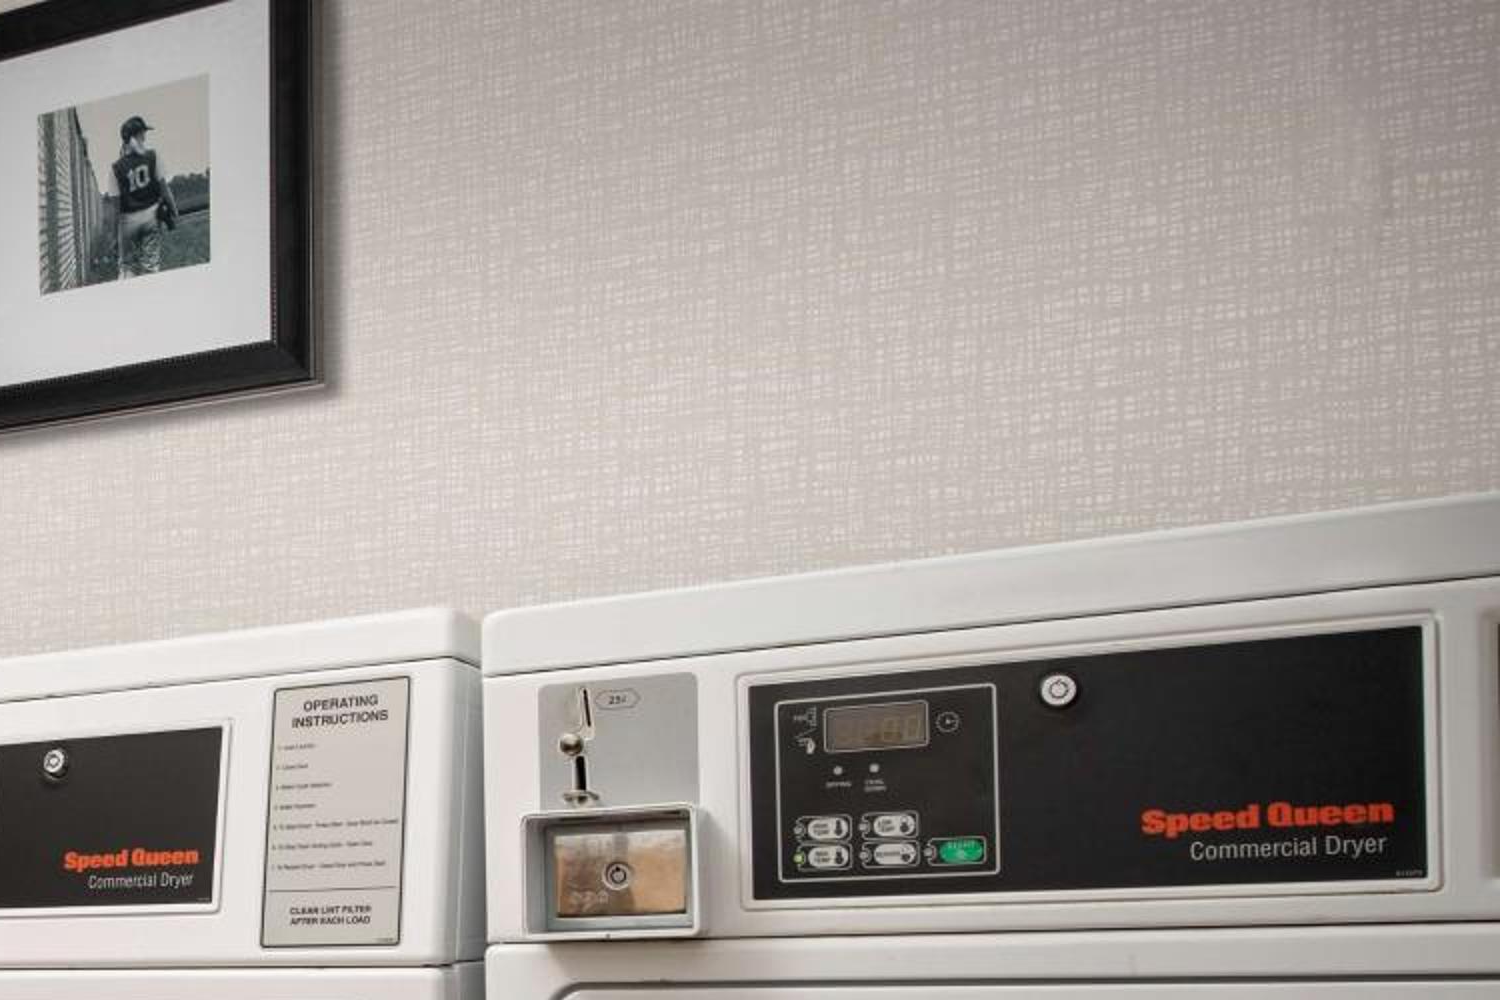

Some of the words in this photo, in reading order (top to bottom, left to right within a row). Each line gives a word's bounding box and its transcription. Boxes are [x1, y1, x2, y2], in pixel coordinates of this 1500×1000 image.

[127, 164, 150, 191] 10
[303, 694, 379, 712] OPERATING
[291, 709, 389, 728] INSTRUCTIONS
[1141, 804, 1260, 838] Speed
[1266, 801, 1394, 827] Queen
[1190, 837, 1317, 860] Commercial
[1325, 834, 1388, 858] Dryer
[64, 850, 128, 872] Speed
[131, 848, 199, 866] Queen
[88, 873, 157, 889] Commercial
[160, 871, 194, 889] Dryer
[290, 906, 319, 915] CLEAN
[321, 906, 340, 915] LINT
[342, 905, 372, 914] FILTER
[290, 917, 318, 925] AFTER
[320, 916, 345, 925] EACH
[346, 915, 371, 924] LOAD
